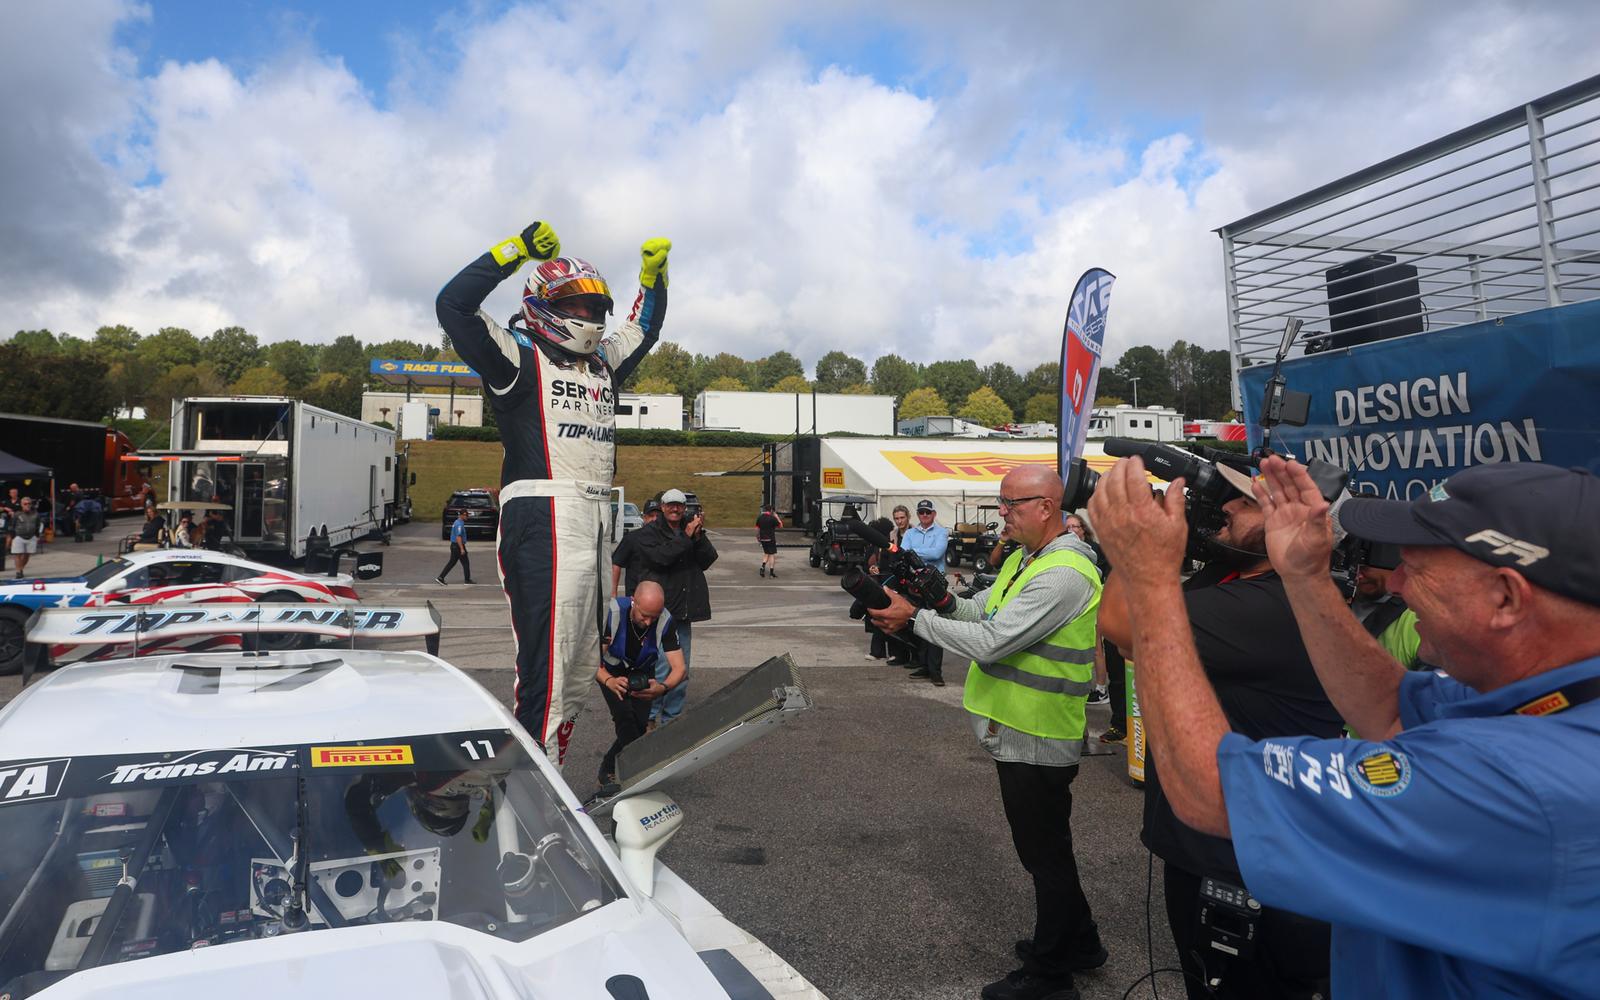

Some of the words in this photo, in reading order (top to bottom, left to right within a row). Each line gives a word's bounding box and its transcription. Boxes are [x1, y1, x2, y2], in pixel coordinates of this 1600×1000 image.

[403, 363, 438, 372] RACE
[440, 365, 471, 373] FUEL
[1335, 372, 1470, 427] DESIGN
[558, 423, 586, 438] TOP
[1305, 418, 1542, 472] INNOVATION
[72, 610, 207, 635] TOP
[320, 749, 403, 763] PIRELLI
[460, 740, 496, 760] 17
[110, 760, 216, 784] Trans
[217, 754, 287, 774] Am
[640, 803, 678, 826] Burtin
[644, 810, 681, 831] RACING
